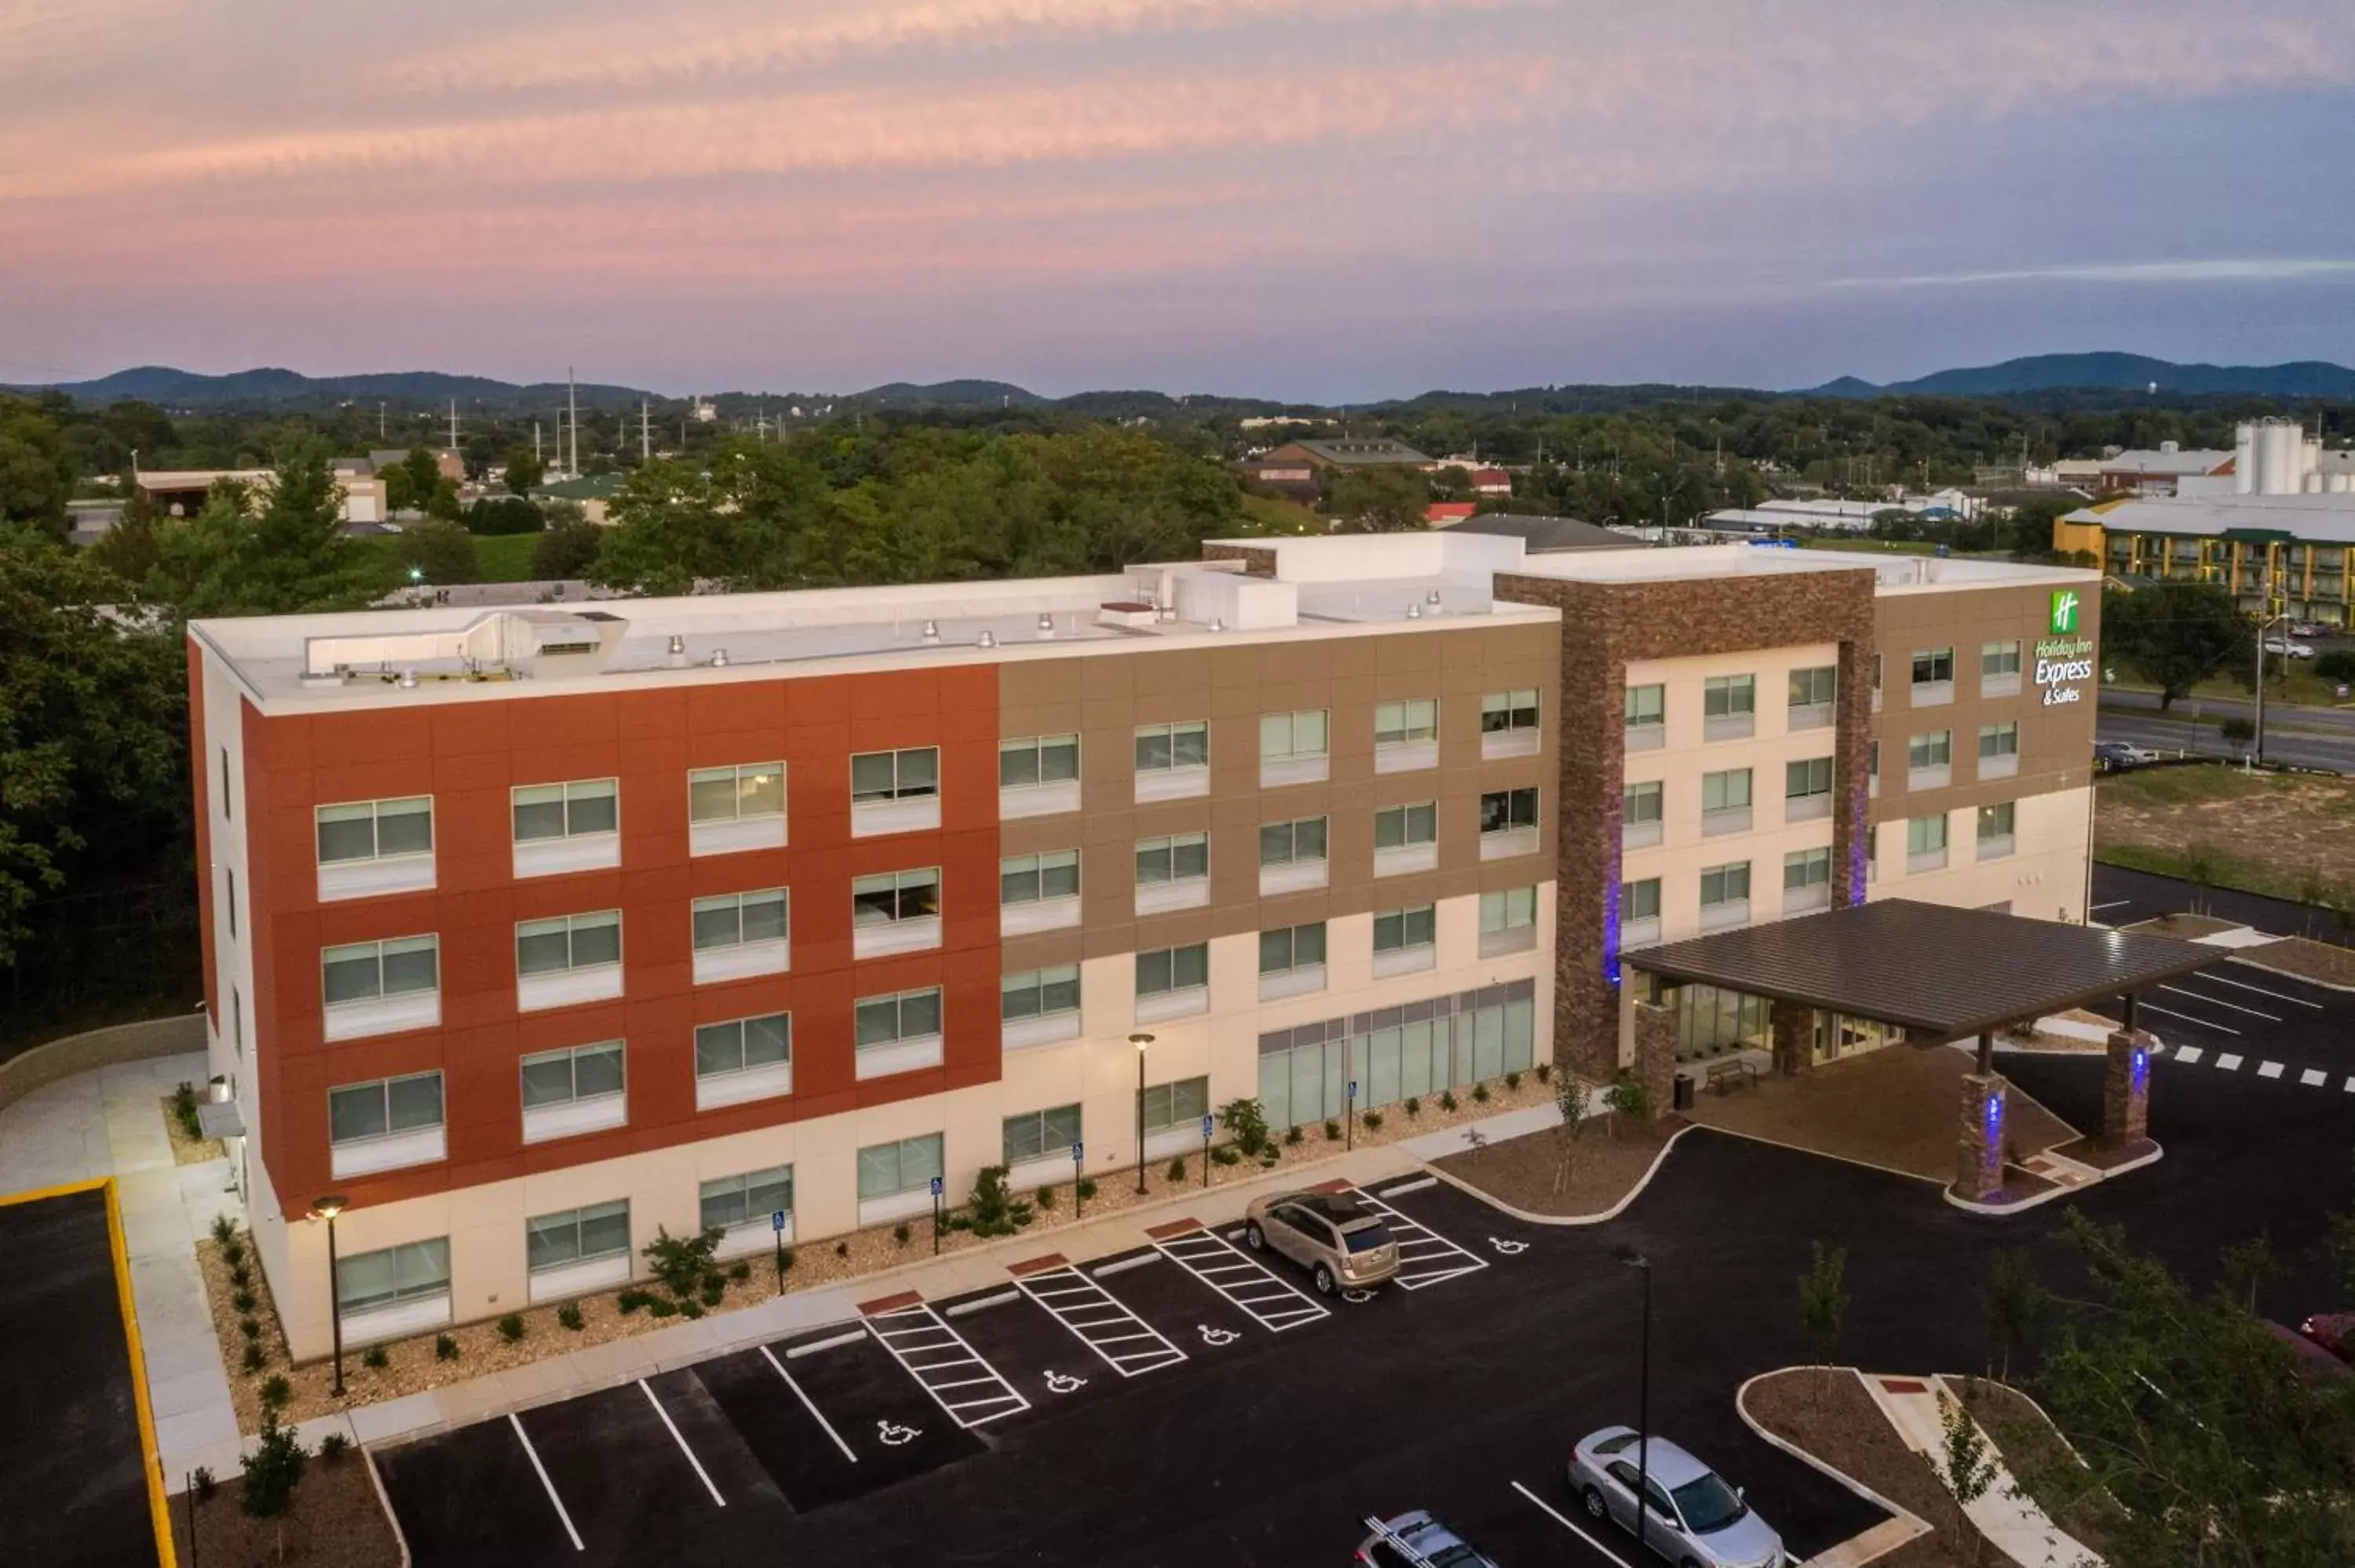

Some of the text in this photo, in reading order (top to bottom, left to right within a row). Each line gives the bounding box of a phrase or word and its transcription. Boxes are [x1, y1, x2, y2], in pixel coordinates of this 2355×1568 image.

[2054, 593, 2079, 630] H
[2036, 638, 2093, 658] Holiday Inn
[2036, 660, 2091, 688] Express
[2043, 689, 2079, 706] & Suites
